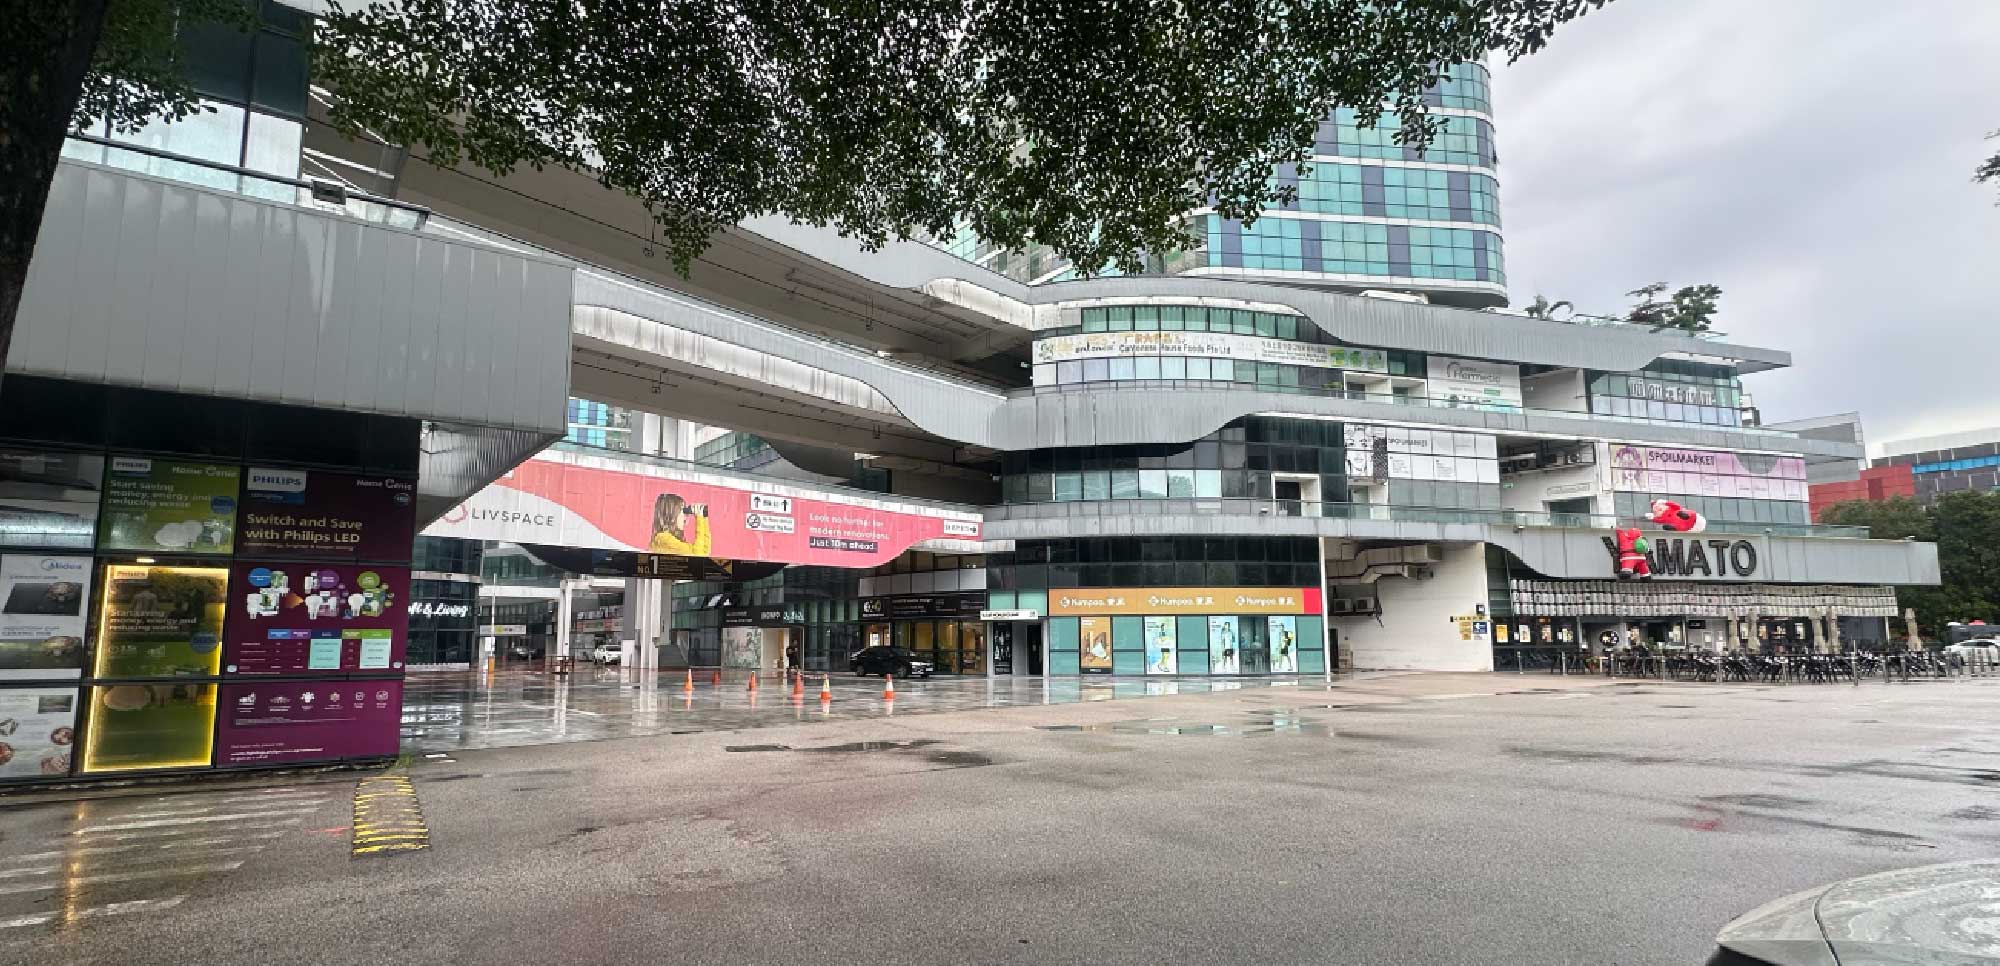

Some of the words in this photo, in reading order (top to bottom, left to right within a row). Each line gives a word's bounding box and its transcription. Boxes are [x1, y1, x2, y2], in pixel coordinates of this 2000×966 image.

[1649, 450, 1715, 466] SPOILMARKET
[252, 475, 302, 486] PHILIPS
[247, 513, 296, 527] Switch
[299, 515, 327, 528] and
[330, 518, 363, 531] Save
[471, 507, 555, 527] LIVSPACE
[245, 528, 280, 540] with
[282, 529, 331, 544] Philips
[333, 532, 360, 543] LED
